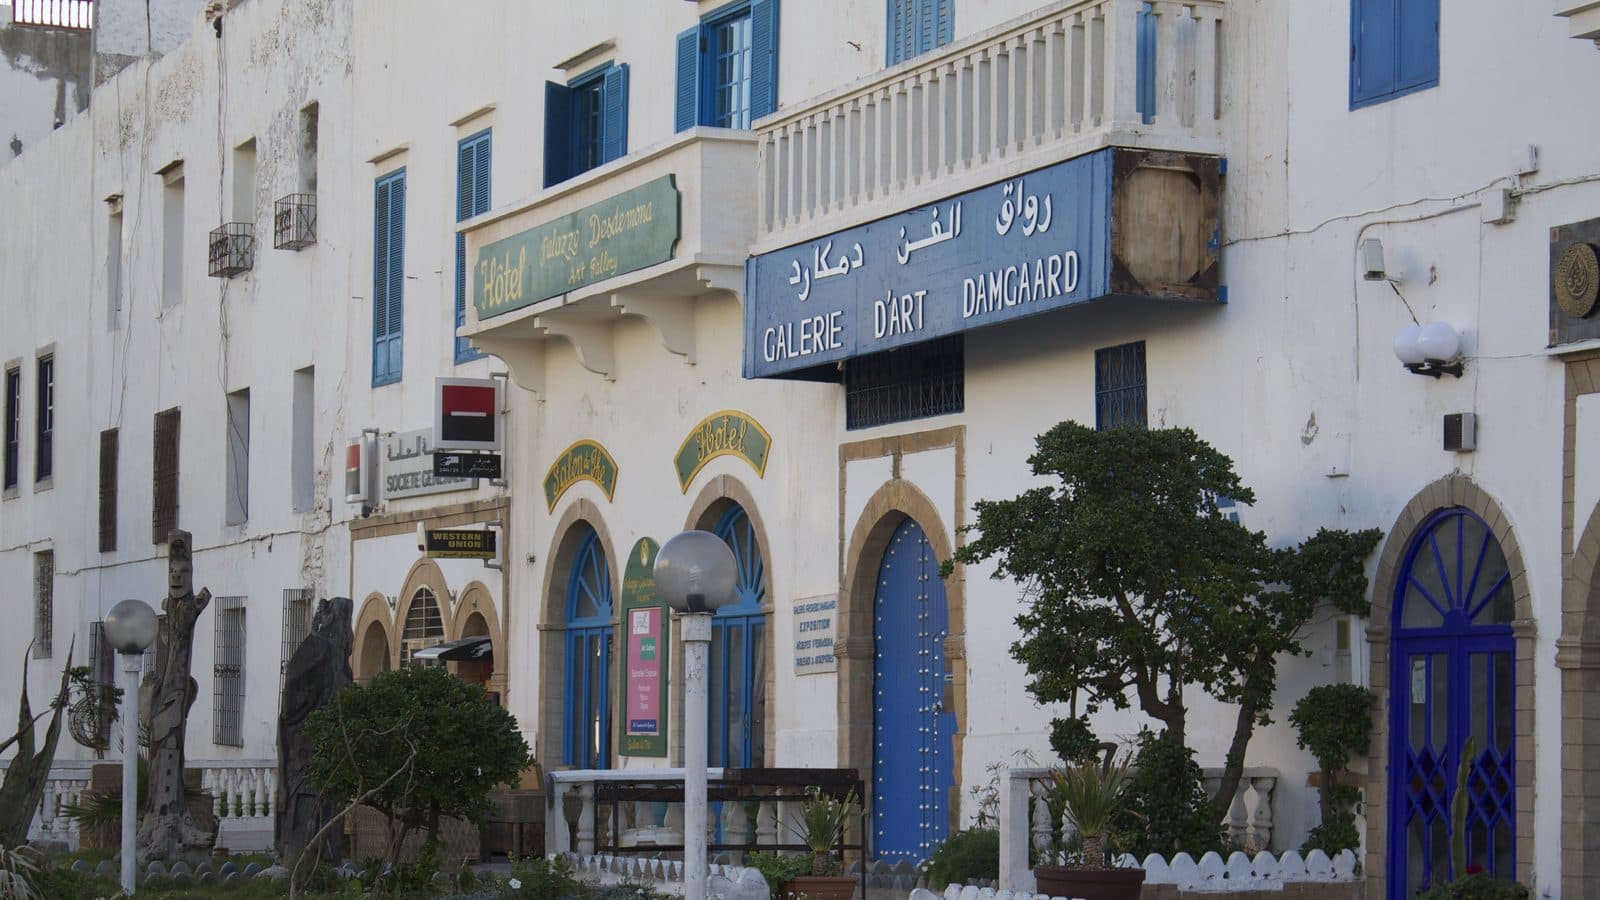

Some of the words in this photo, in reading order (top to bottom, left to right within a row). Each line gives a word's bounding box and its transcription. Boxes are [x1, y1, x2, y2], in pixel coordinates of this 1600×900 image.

[896, 201, 962, 265] الفن
[995, 179, 1052, 237] رواق
[480, 245, 526, 311] Hôtel
[589, 201, 654, 248] Desdemona
[789, 240, 863, 301] دمكارد
[763, 309, 844, 363] GALERIE
[874, 289, 928, 339] D'ART
[963, 250, 1079, 319] DAMGAARD
[696, 415, 746, 462] Hotel
[387, 471, 420, 492] SOCIETE
[432, 532, 481, 541] WESTERN
[448, 541, 481, 549] UNION
